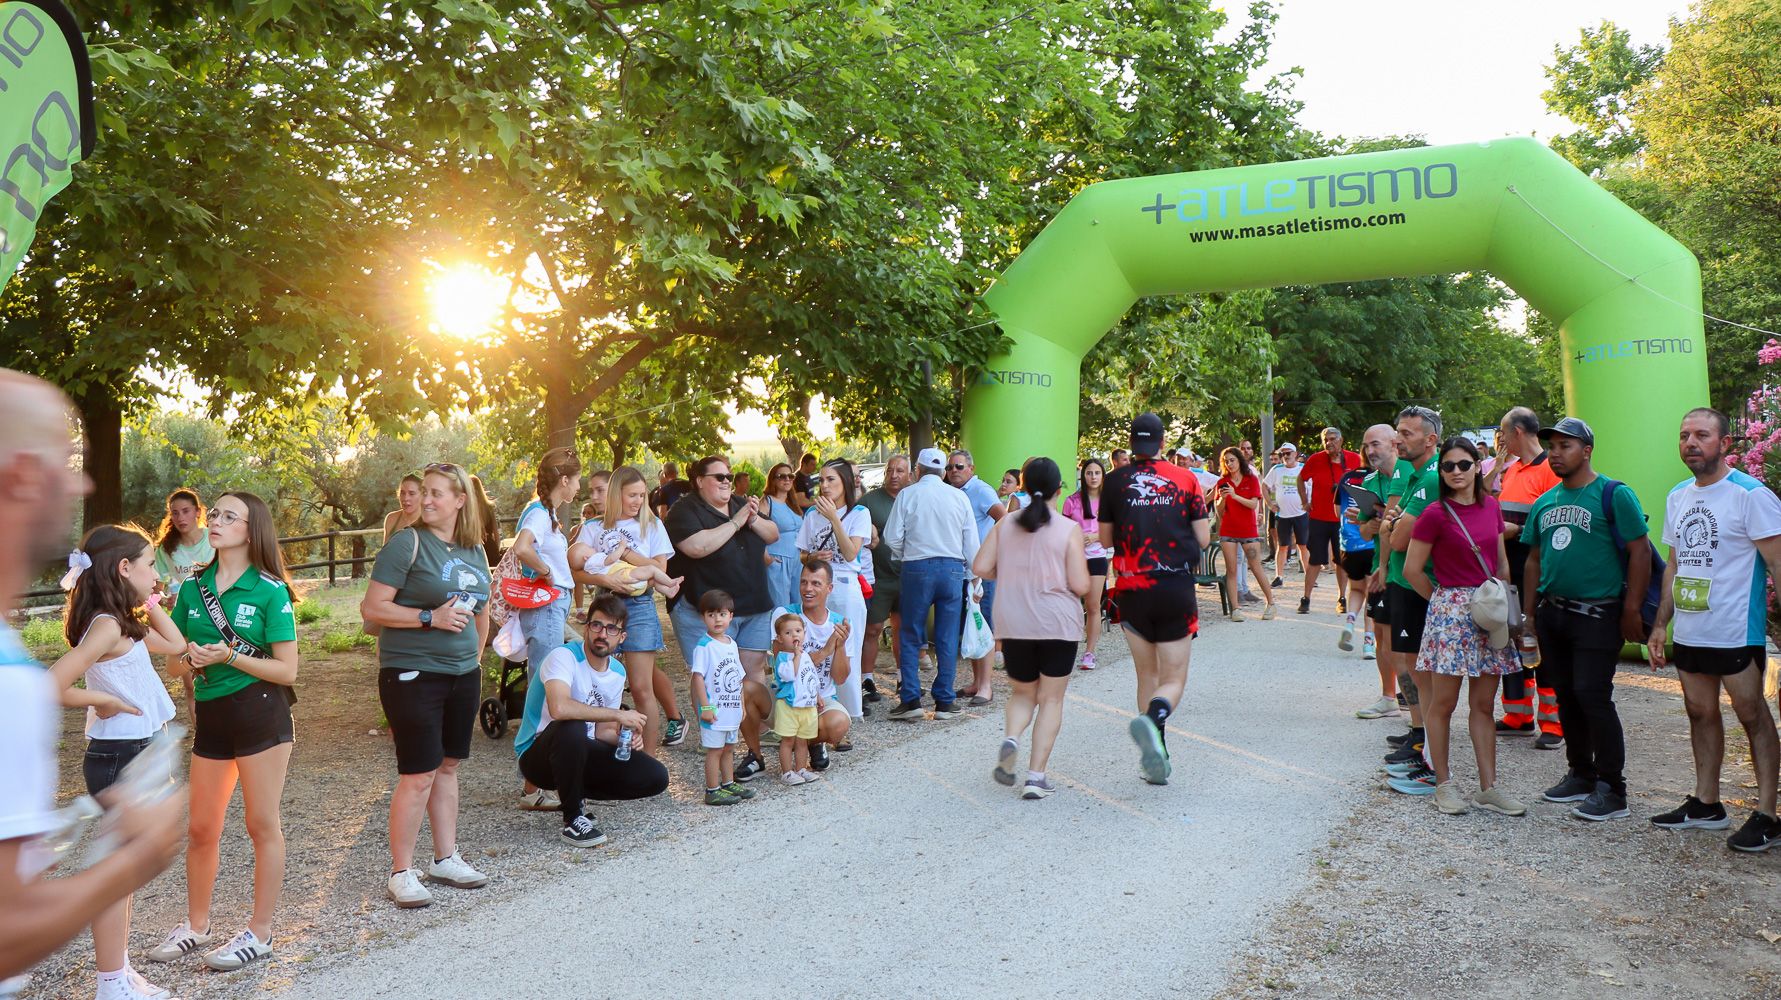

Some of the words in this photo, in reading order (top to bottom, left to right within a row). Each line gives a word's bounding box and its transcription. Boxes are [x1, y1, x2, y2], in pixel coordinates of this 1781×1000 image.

[1189, 210, 1406, 244] www.masatletismo.com
[1540, 504, 1591, 534] THRIVE
[1701, 506, 1718, 538] MEMORIAL
[1680, 587, 1697, 601] 94
